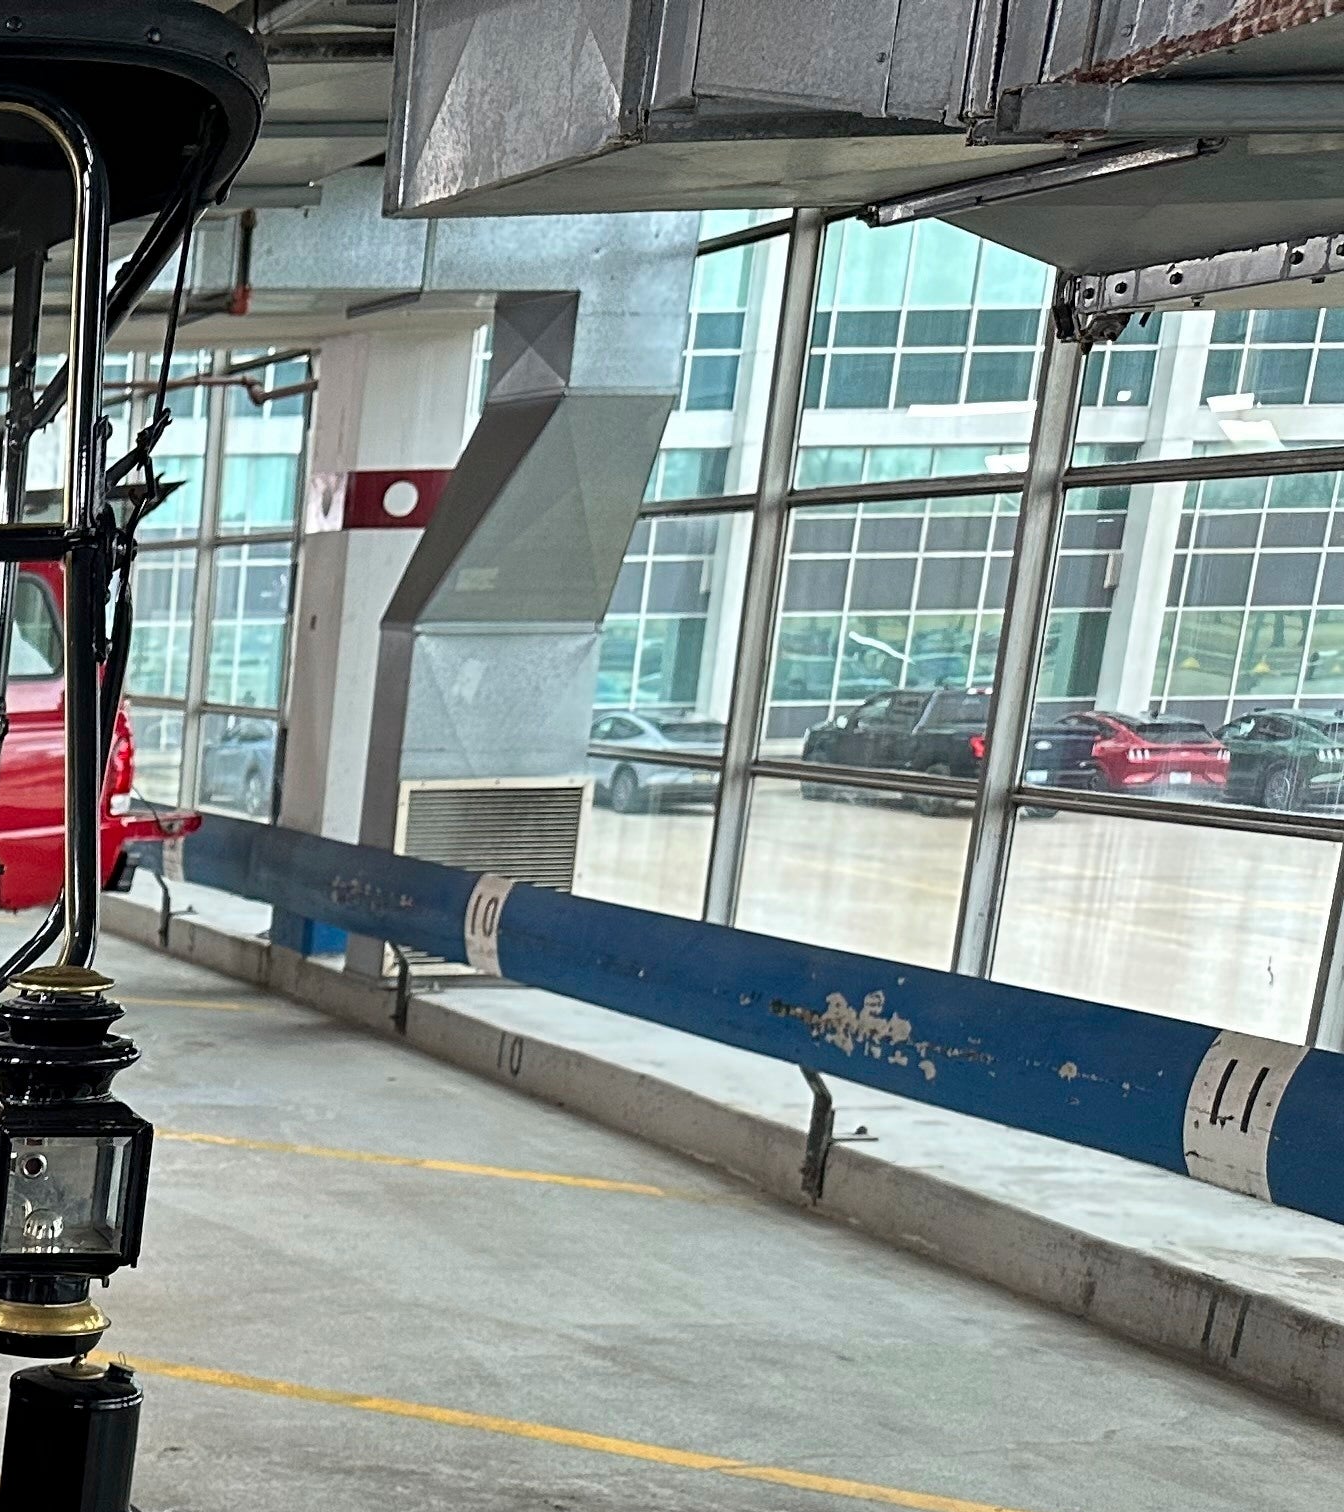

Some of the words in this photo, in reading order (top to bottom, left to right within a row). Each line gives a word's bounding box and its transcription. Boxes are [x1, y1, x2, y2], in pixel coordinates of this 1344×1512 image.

[470, 893, 499, 937] 10
[497, 1030, 524, 1077] 10
[1209, 1058, 1270, 1133] 11
